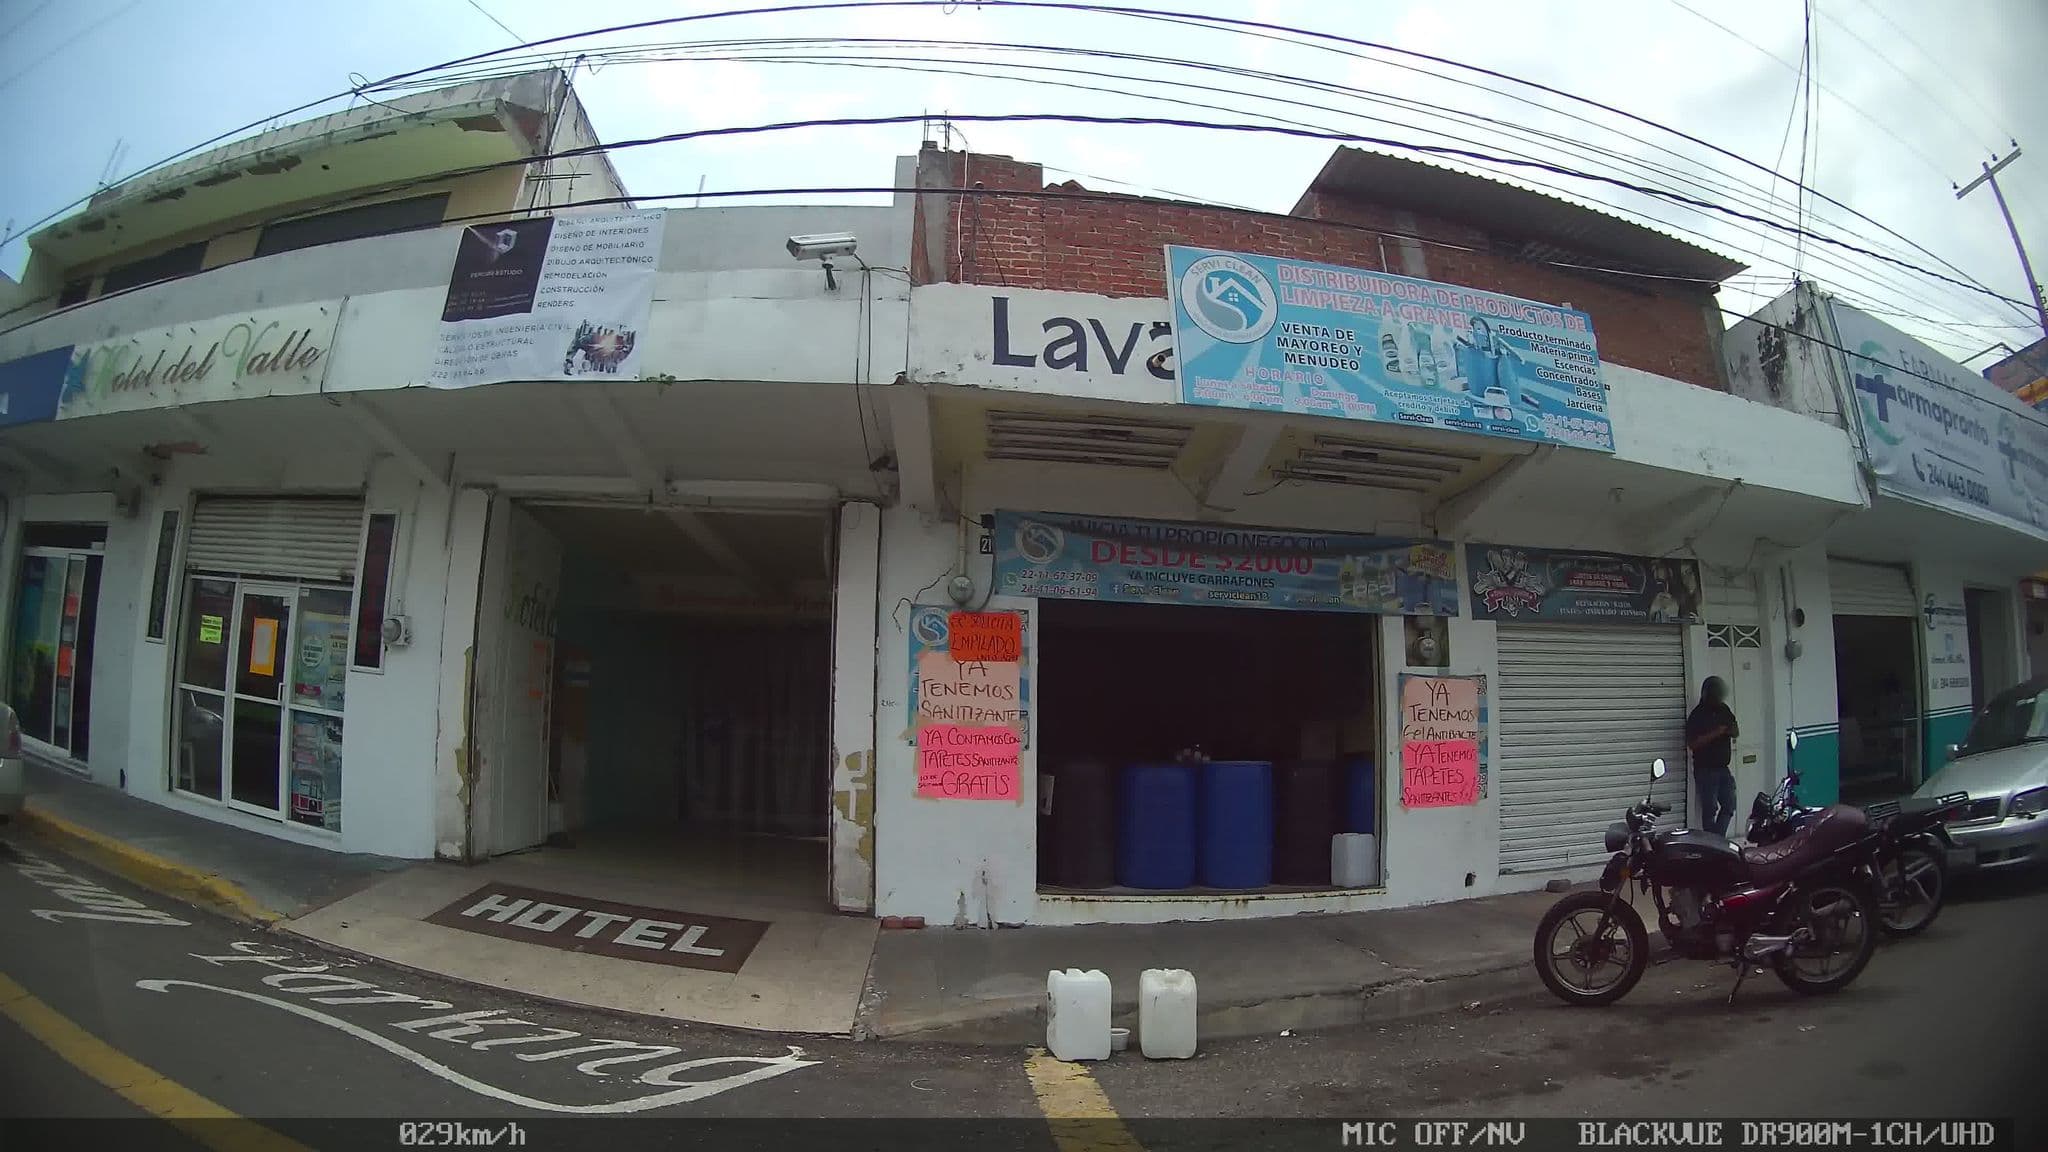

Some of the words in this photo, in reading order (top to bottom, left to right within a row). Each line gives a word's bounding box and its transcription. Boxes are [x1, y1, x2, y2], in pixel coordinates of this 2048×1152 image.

[585, 229, 597, 238] DE
[598, 226, 650, 236] INTERIORES
[582, 243, 594, 252] DE
[595, 240, 645, 250] MOBILIARIO
[546, 257, 577, 266] DIBUJO
[537, 299, 575, 309] RENDERS
[1278, 264, 1432, 301] DISTRIBUIDORA
[1436, 288, 1461, 307] DE
[1463, 294, 1564, 328] PRODUCTOS
[1565, 315, 1587, 332] DE
[1280, 285, 1376, 315] LIMPIEZA
[1383, 301, 1395, 318] A
[1400, 304, 1472, 331] GRANEL
[1281, 322, 1330, 339] VENTA
[1335, 329, 1355, 341] DE
[1498, 324, 1543, 342] Producto
[1544, 334, 1592, 351] terminado
[163, 341, 220, 385] del
[222, 319, 324, 380] Valle
[1276, 336, 1349, 355] MAYOREO
[1354, 345, 1362, 357] Y
[1530, 342, 1567, 358] Materia
[1568, 350, 1595, 364] prima
[1284, 352, 1360, 371] MENUDEO
[1554, 358, 1597, 376] Escencias
[1245, 367, 1325, 386] HORARIO
[1536, 367, 1599, 388] Concentrados
[1575, 386, 1602, 400] Bases
[1090, 540, 1207, 571] DESDE
[1127, 570, 1144, 580] YA
[1145, 571, 1195, 584] INCLUYE
[1198, 573, 1275, 589] GARRAFONES
[955, 660, 989, 681] YA
[921, 678, 1014, 701] TENEMOS
[1424, 681, 1450, 707] YA
[1409, 703, 1475, 722] TENEMOS
[924, 728, 943, 746] YA
[921, 749, 972, 769] TAPETES
[1407, 743, 1437, 765] YA
[1406, 765, 1465, 787] TAPETES
[461, 893, 726, 957] HOTEL
